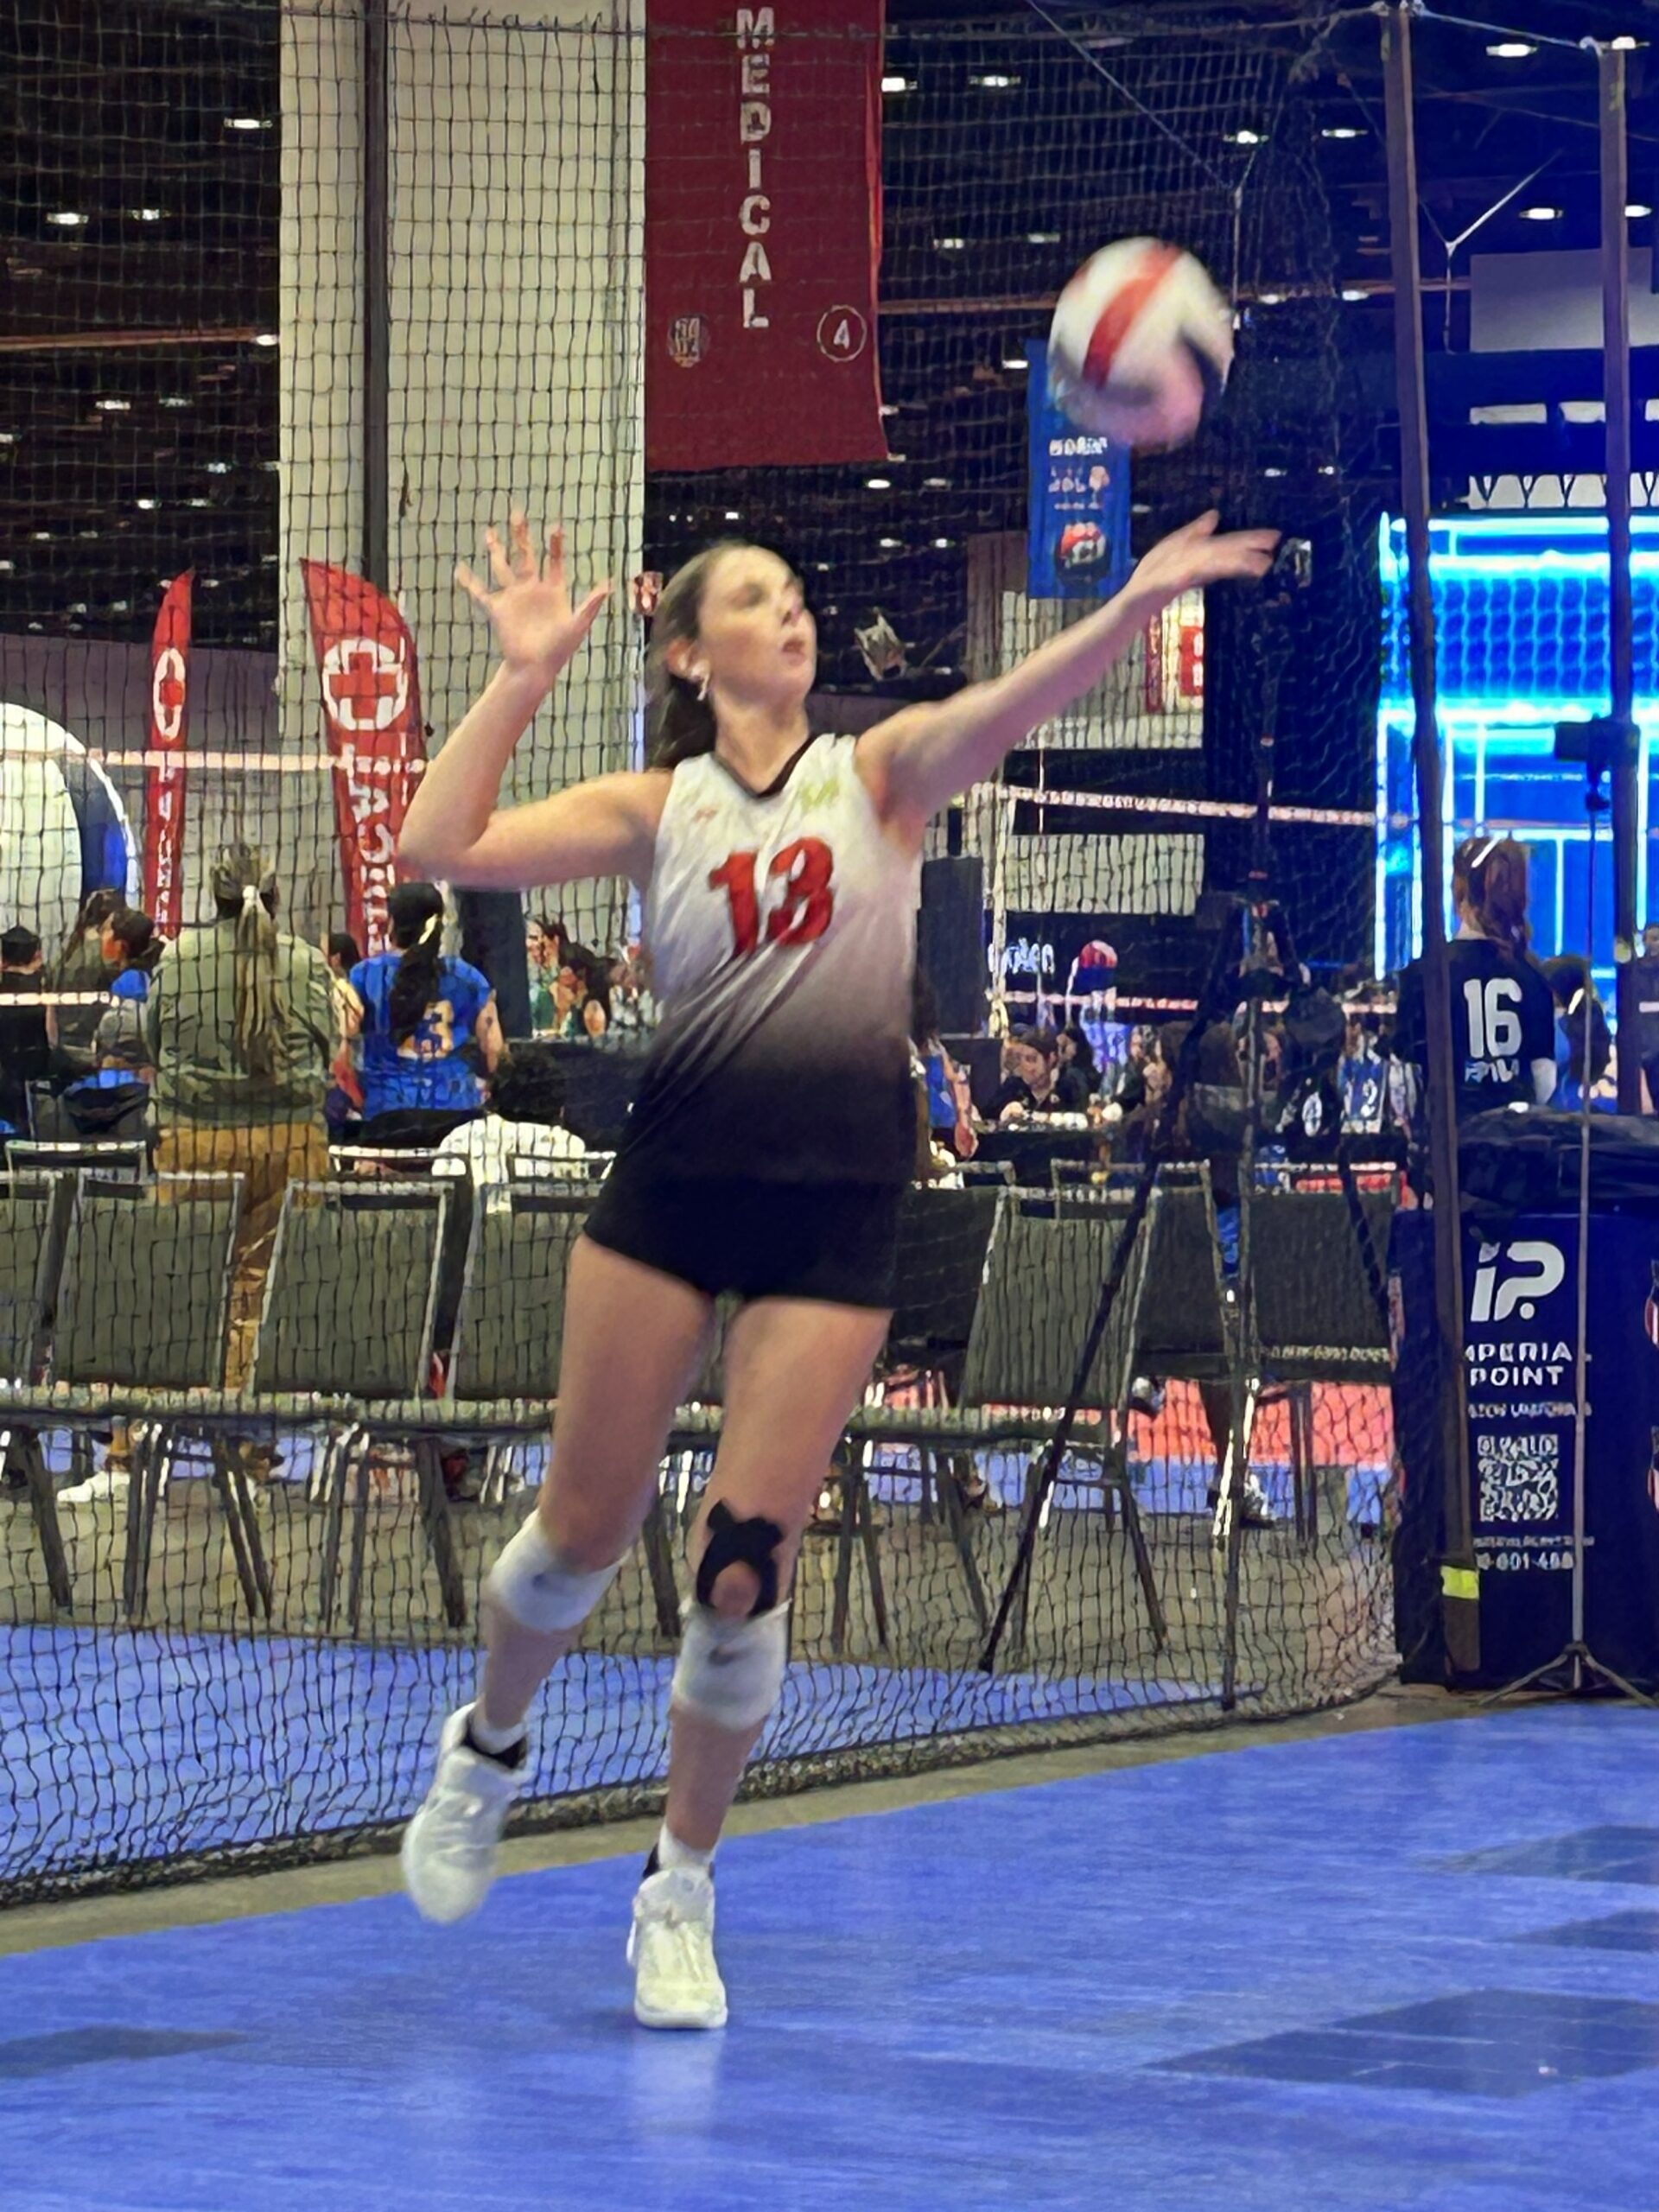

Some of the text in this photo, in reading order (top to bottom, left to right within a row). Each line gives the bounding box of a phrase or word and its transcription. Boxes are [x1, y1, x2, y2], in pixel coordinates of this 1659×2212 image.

[736, 7, 775, 328] MEDICAL
[709, 837, 834, 954] 13
[1463, 977, 1522, 1058] 16
[1470, 1365, 1563, 1386] POINT
